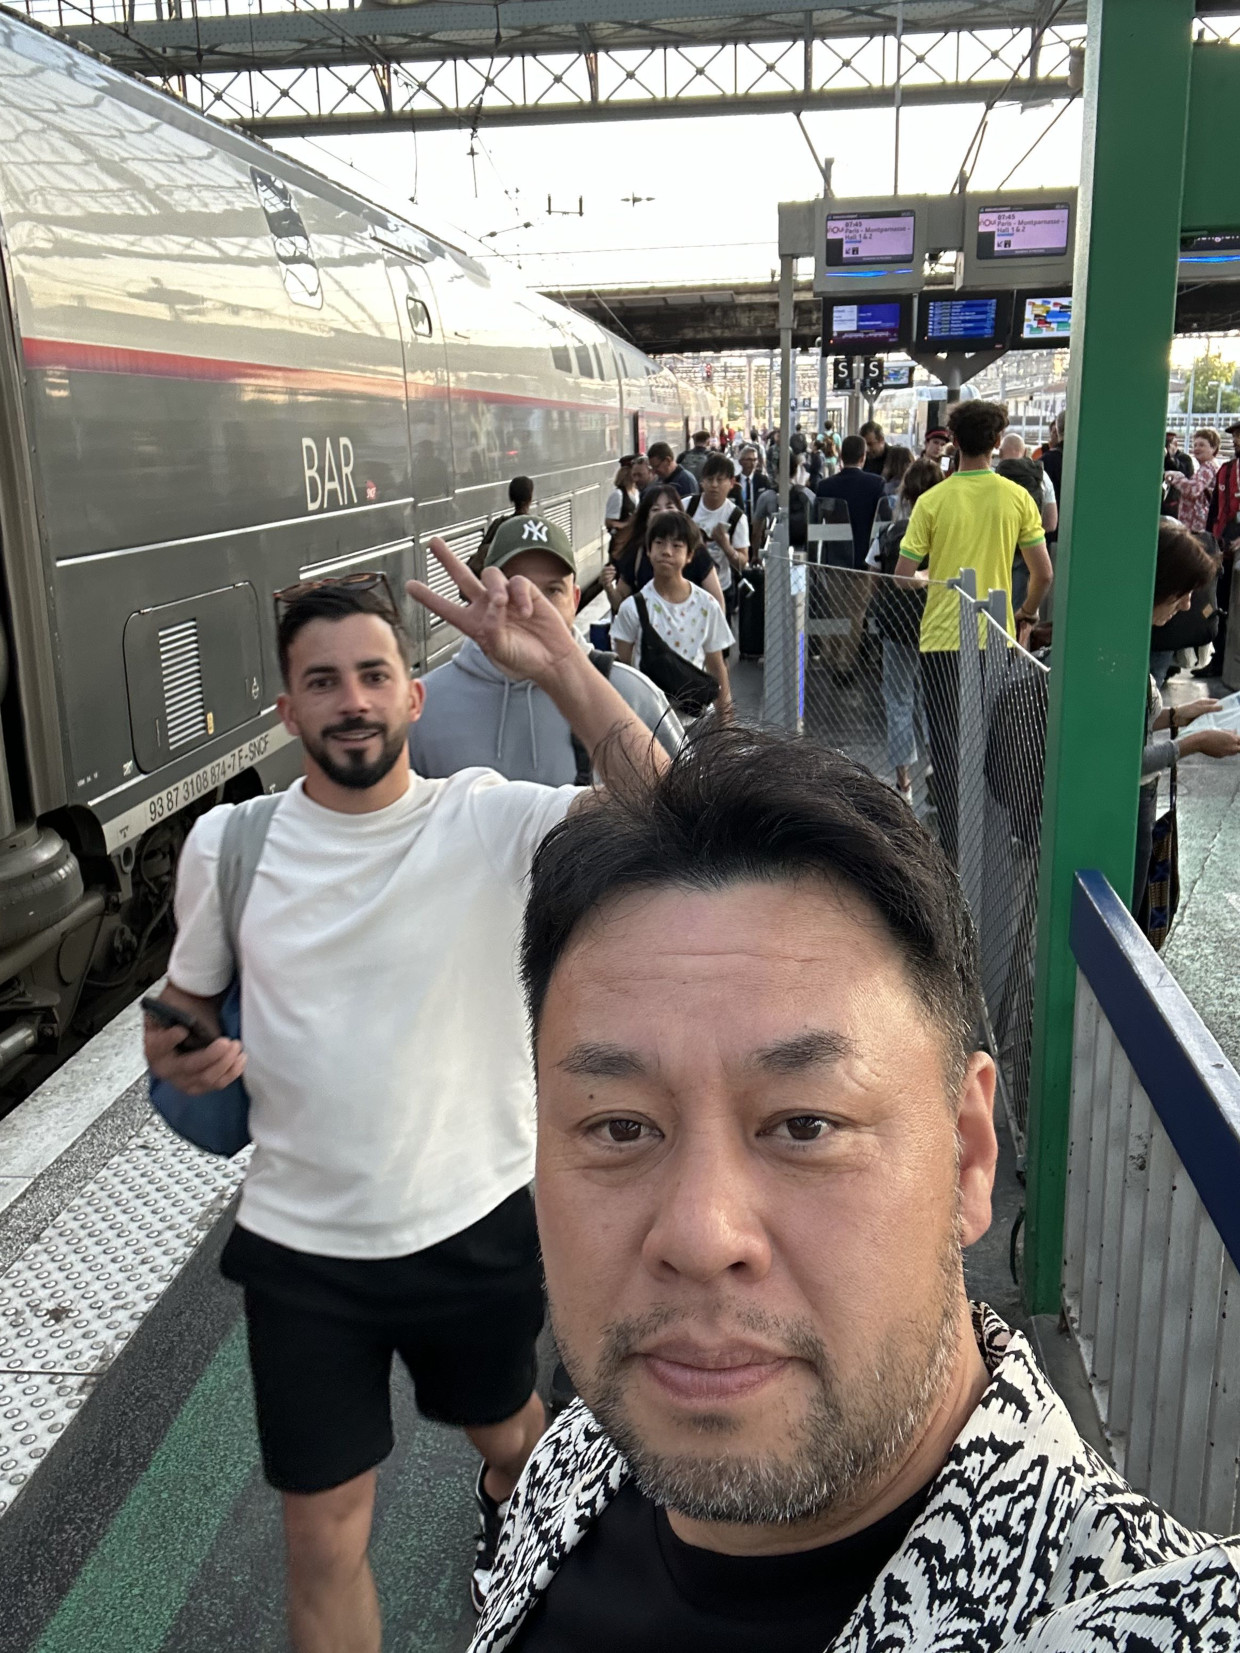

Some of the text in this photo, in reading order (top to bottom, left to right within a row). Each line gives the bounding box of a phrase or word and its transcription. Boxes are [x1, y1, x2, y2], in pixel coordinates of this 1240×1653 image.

[865, 226, 906, 234] Montparnasse
[1017, 219, 1060, 227] Montparnasse
[838, 362, 849, 378] S
[869, 361, 879, 377] S
[301, 436, 358, 512] BAR
[521, 519, 549, 543] NY
[149, 797, 164, 822] 93
[166, 787, 179, 812] 87
[183, 770, 209, 801] 3108
